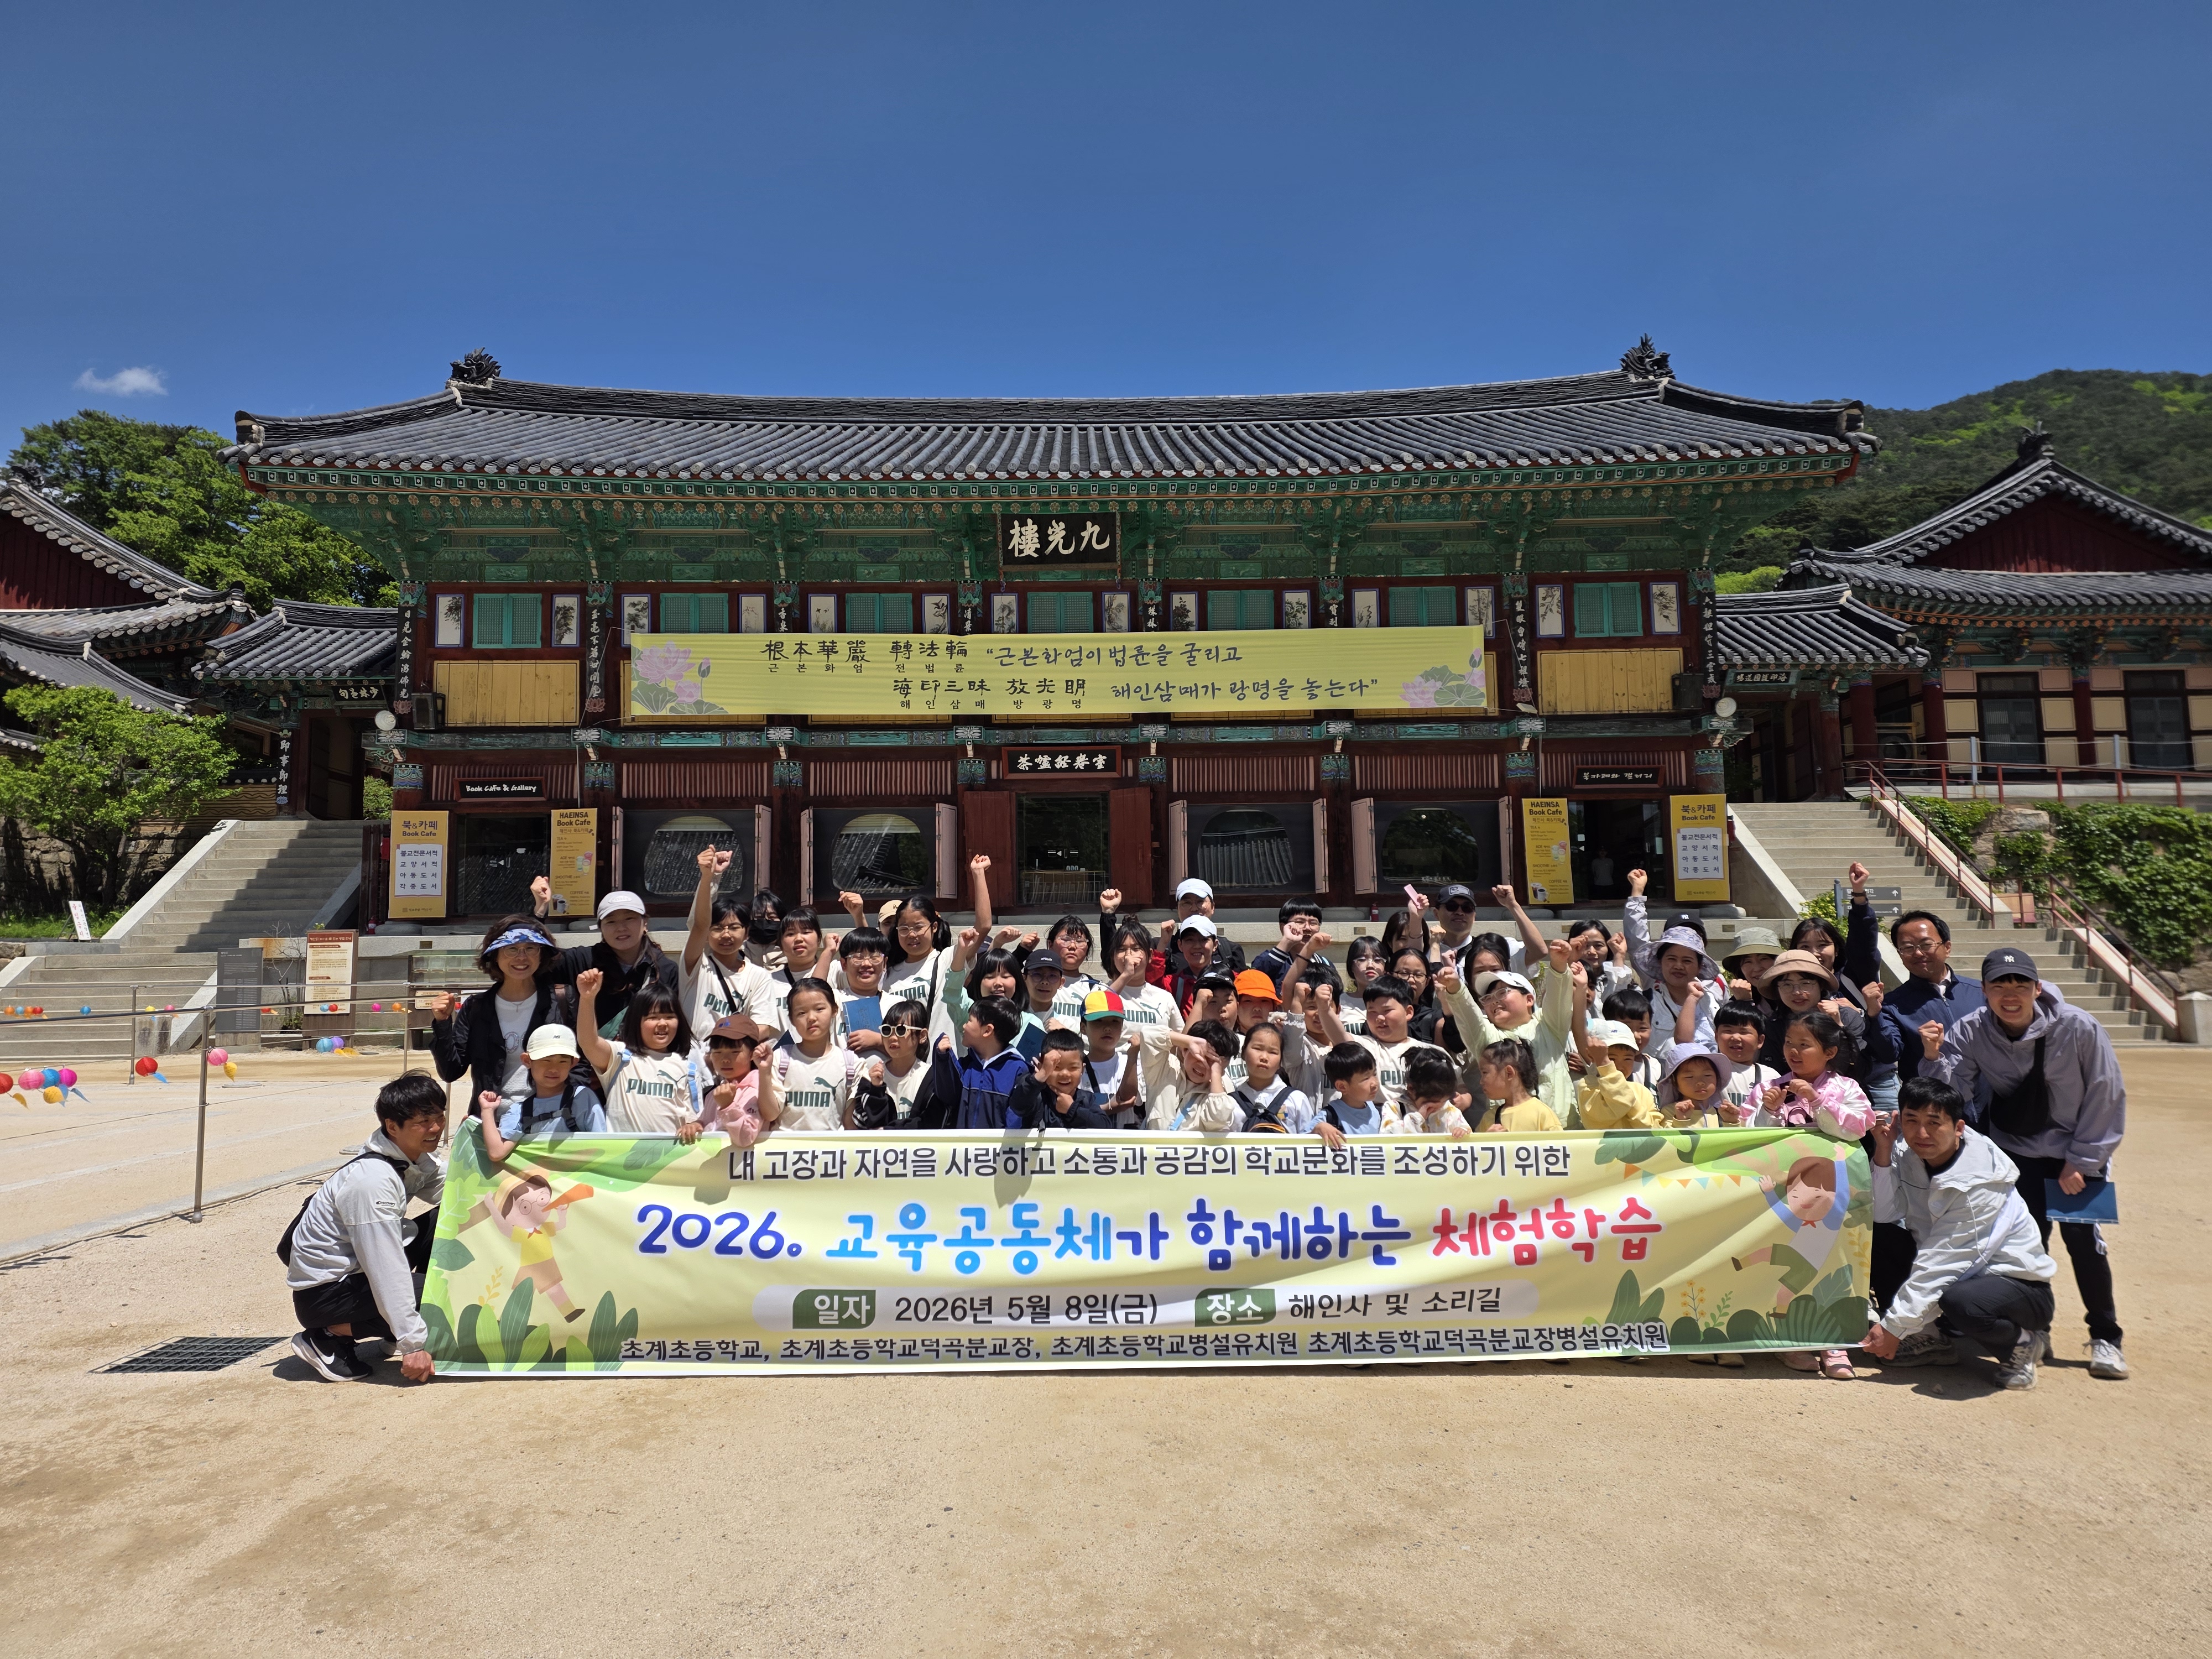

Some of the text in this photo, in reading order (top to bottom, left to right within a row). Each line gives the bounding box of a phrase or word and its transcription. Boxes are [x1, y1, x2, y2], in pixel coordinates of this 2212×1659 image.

[1109, 645, 1173, 667] 법륜을
[1180, 642, 1244, 665] 굴리고
[1111, 681, 1222, 702] 해인삼매가
[1229, 679, 1295, 700] 광명을
[1681, 804, 1717, 813] 북&카페
[401, 820, 437, 830] 북&카페
[1124, 1009, 1156, 1024] UMA
[625, 1078, 674, 1099] PUMA
[785, 1092, 830, 1108] PUMA
[729, 1145, 1570, 1181] 내 고장과 자연을 사랑하고 소통과 공감의 학교문화를 조성하기 위한
[825, 1202, 1169, 1274] 교육공동체가
[1187, 1198, 1411, 1271] 함께하는
[1432, 1197, 1662, 1266] 체험학습
[813, 1287, 1502, 1326] 일자 2026년 5월 8일(금) 장소 해인사 및 소리길
[621, 1323, 1669, 1363] 초계초등학교, 초계초등학교덕곡분교장, 초계초등학교병설유치원 초계초등학교덕곡분교장병설유치원
